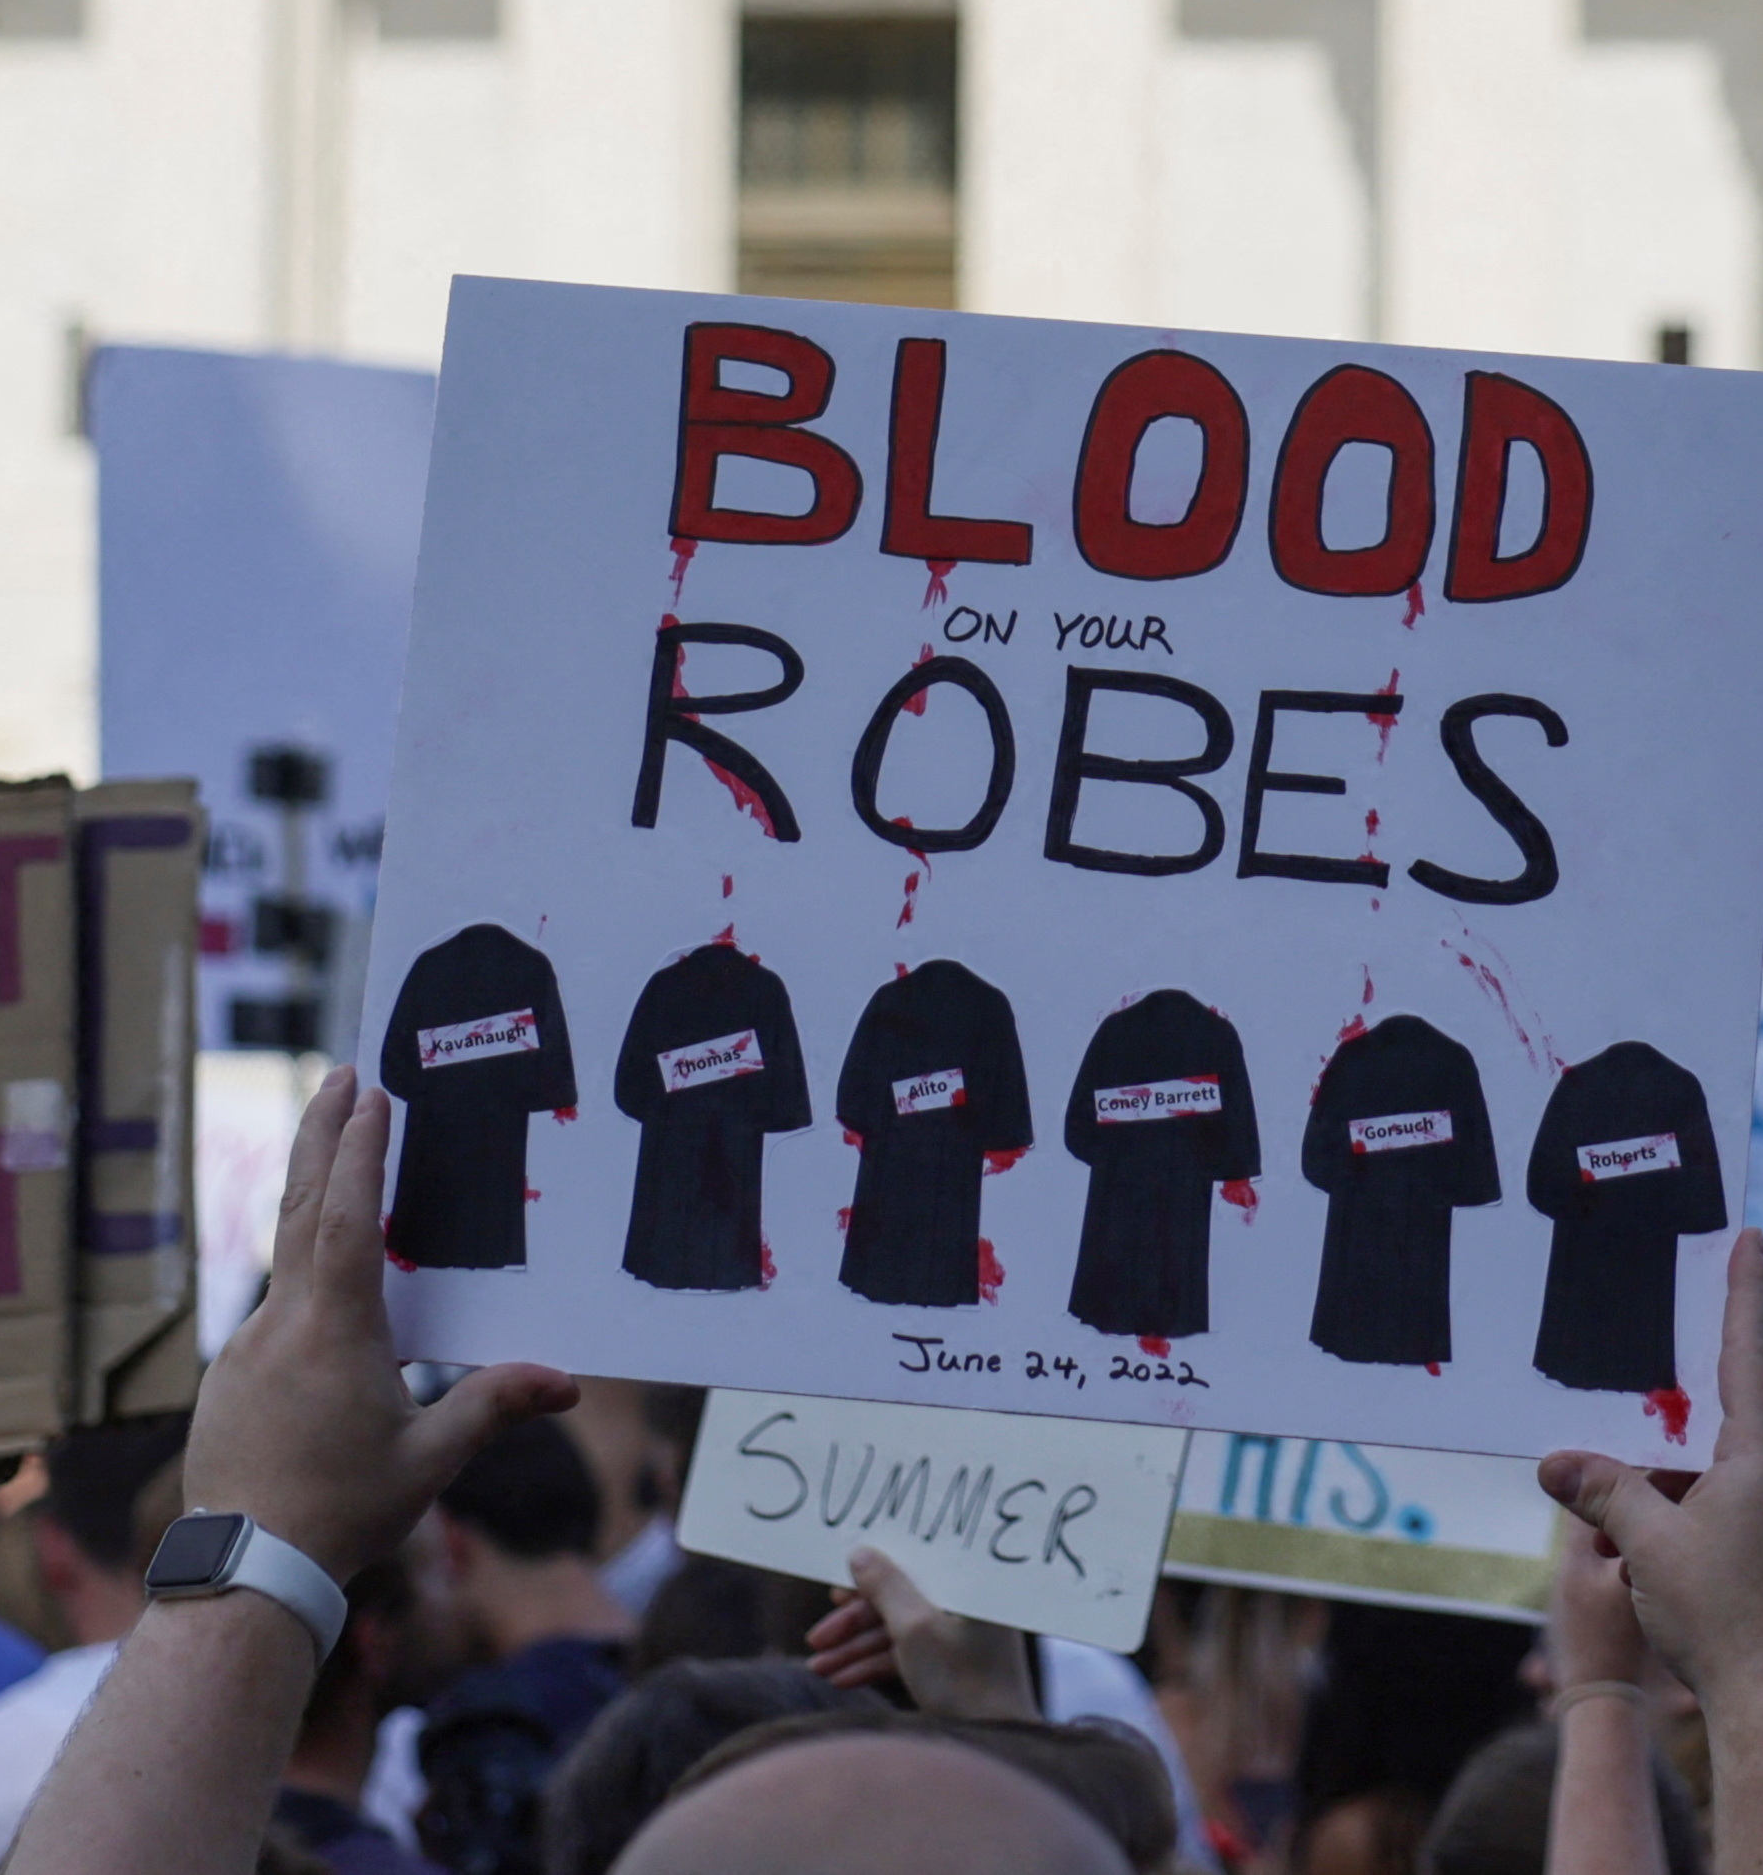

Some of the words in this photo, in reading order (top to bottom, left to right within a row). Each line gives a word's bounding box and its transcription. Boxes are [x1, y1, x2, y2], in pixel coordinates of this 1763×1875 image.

[670, 322, 1594, 605] BLOOD
[943, 605, 1018, 645] ON
[1053, 611, 1174, 655] YOUR
[630, 621, 1569, 905] ROBES
[431, 1022, 527, 1054] Kavanaugh
[673, 1046, 742, 1077] Thomas
[908, 1078, 949, 1099] Alito
[1097, 1091, 1151, 1112] Coney
[1154, 1085, 1216, 1107] Barrett
[1363, 1116, 1435, 1140] Gorsuch
[1589, 1145, 1657, 1169] Roberts
[891, 1332, 1002, 1373] June
[1025, 1350, 1086, 1390] 24,
[1109, 1355, 1211, 1389] 2022
[737, 1410, 1099, 1579] SUMMER
